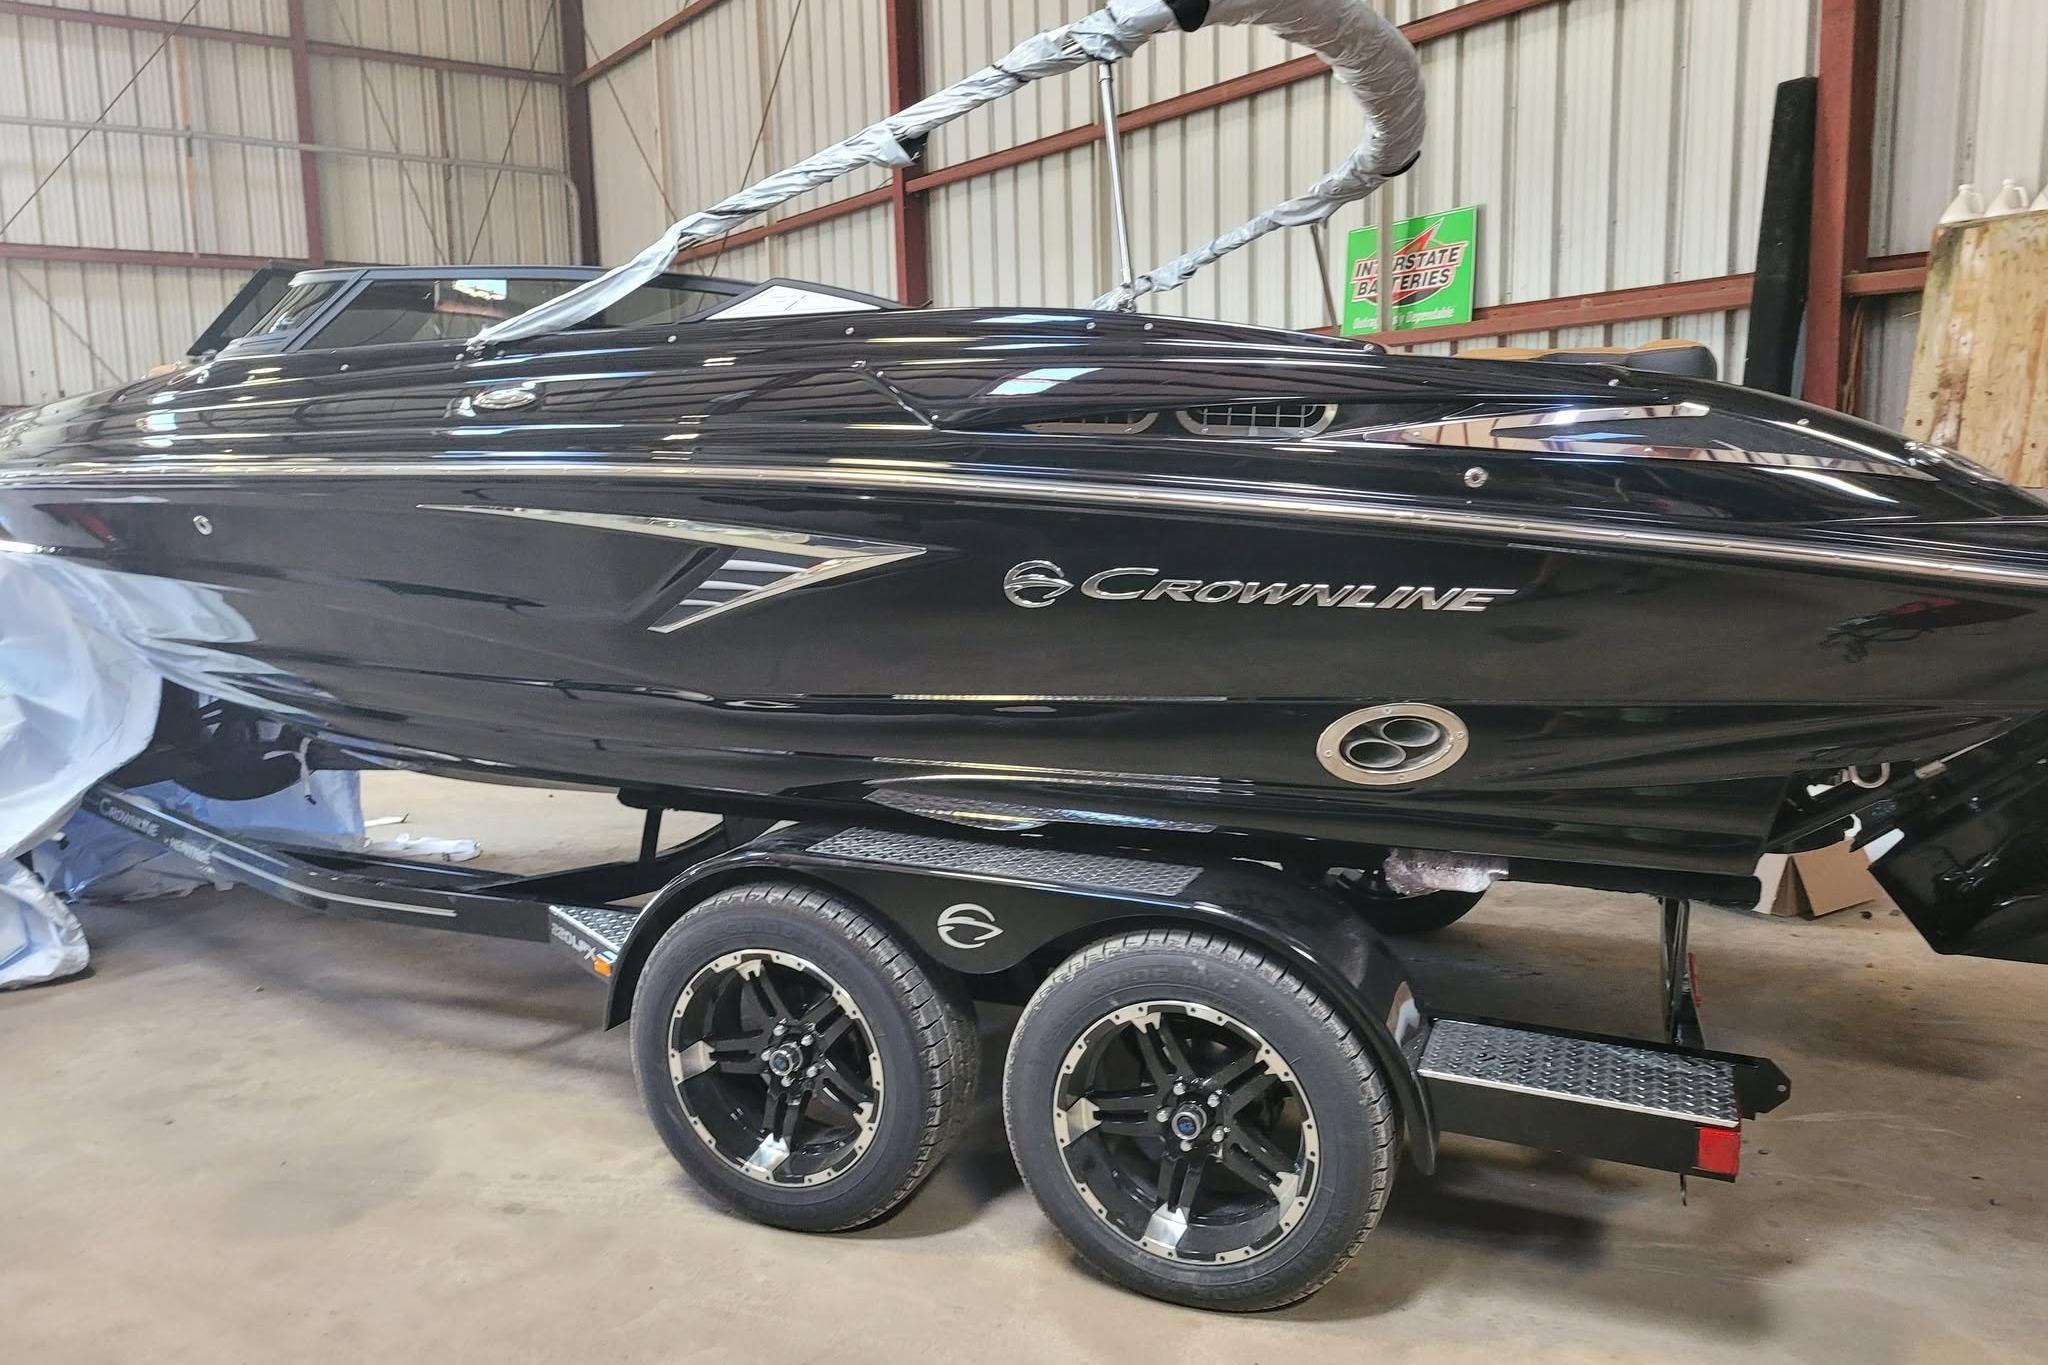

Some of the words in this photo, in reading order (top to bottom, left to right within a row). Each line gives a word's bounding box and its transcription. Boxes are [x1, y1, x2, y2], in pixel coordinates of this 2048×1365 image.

[1355, 246, 1460, 278] INRSTATE
[1357, 268, 1450, 297] BATERIES
[1080, 567, 1519, 612] CROWNLINE
